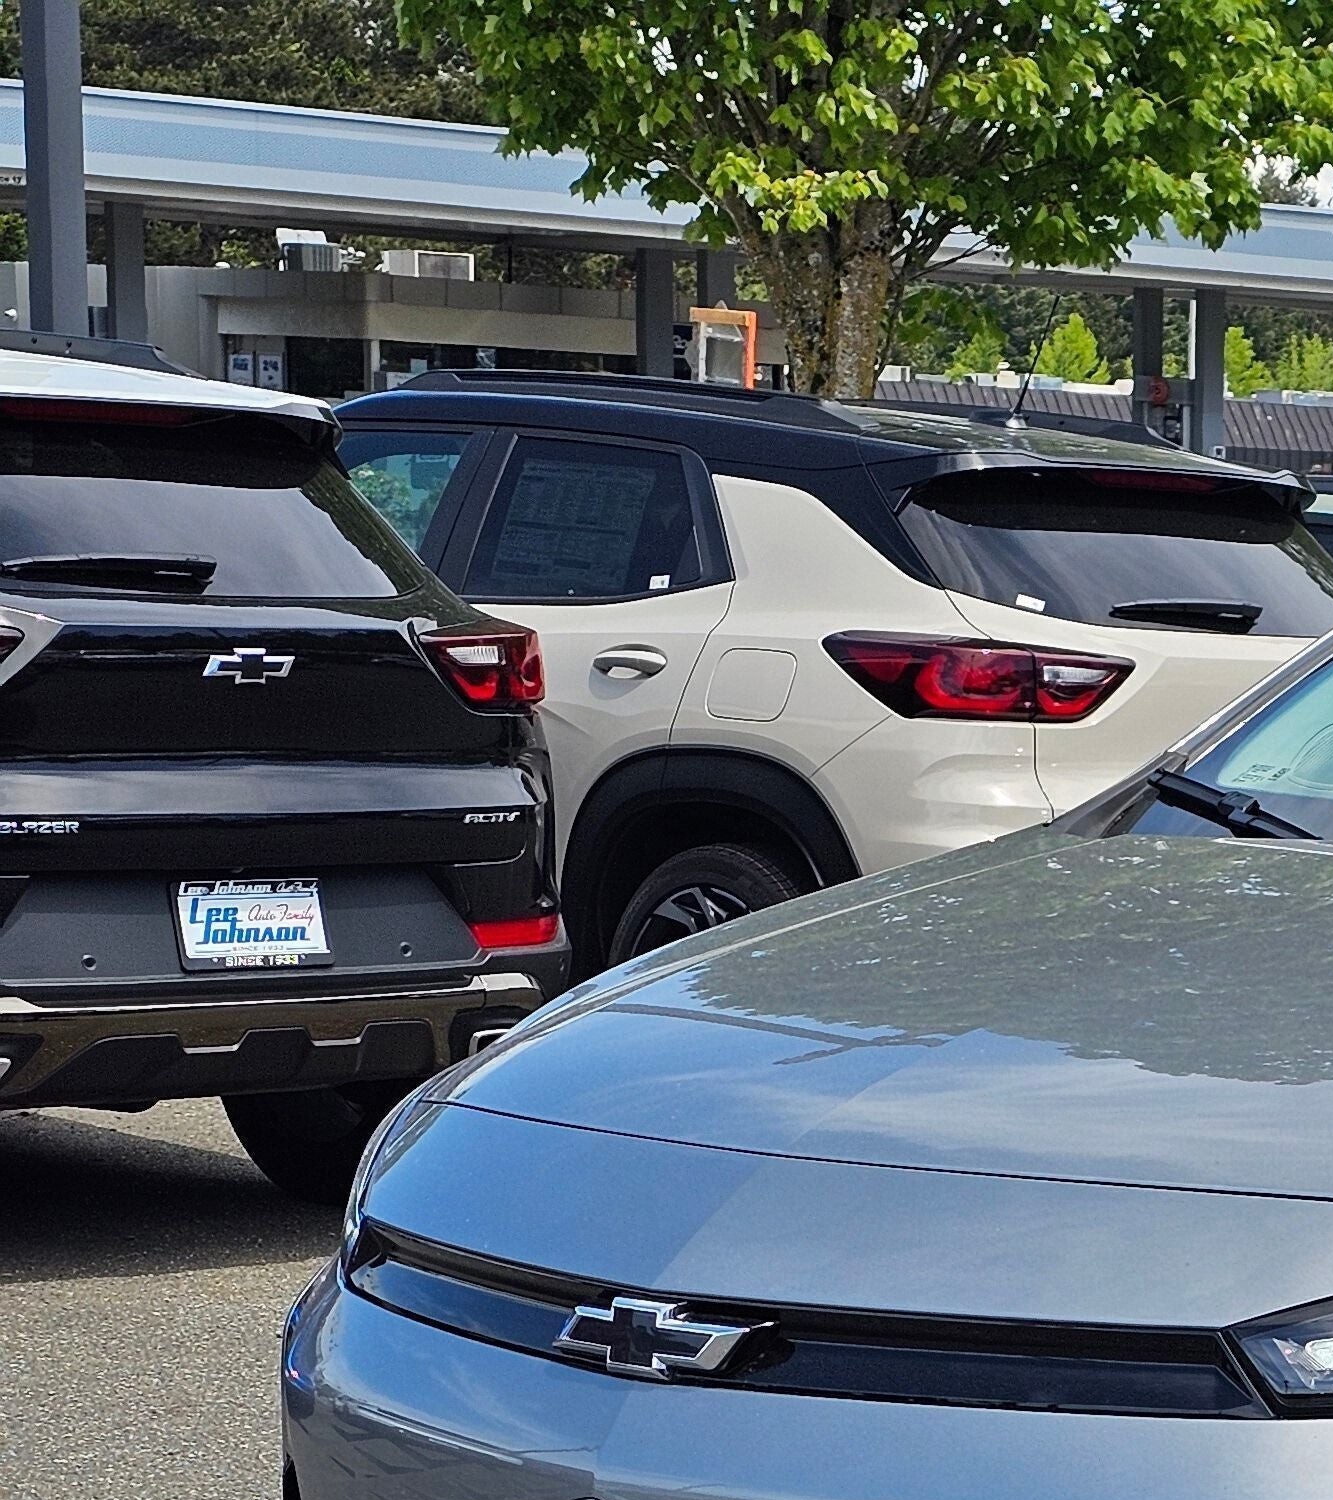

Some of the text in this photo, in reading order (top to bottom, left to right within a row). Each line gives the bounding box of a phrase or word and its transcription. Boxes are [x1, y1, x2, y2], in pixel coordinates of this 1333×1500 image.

[210, 880, 274, 895] Johnson
[189, 897, 244, 925] Lee
[247, 903, 277, 922] Auto
[195, 918, 311, 945] Johnson
[225, 955, 265, 967] SINCE
